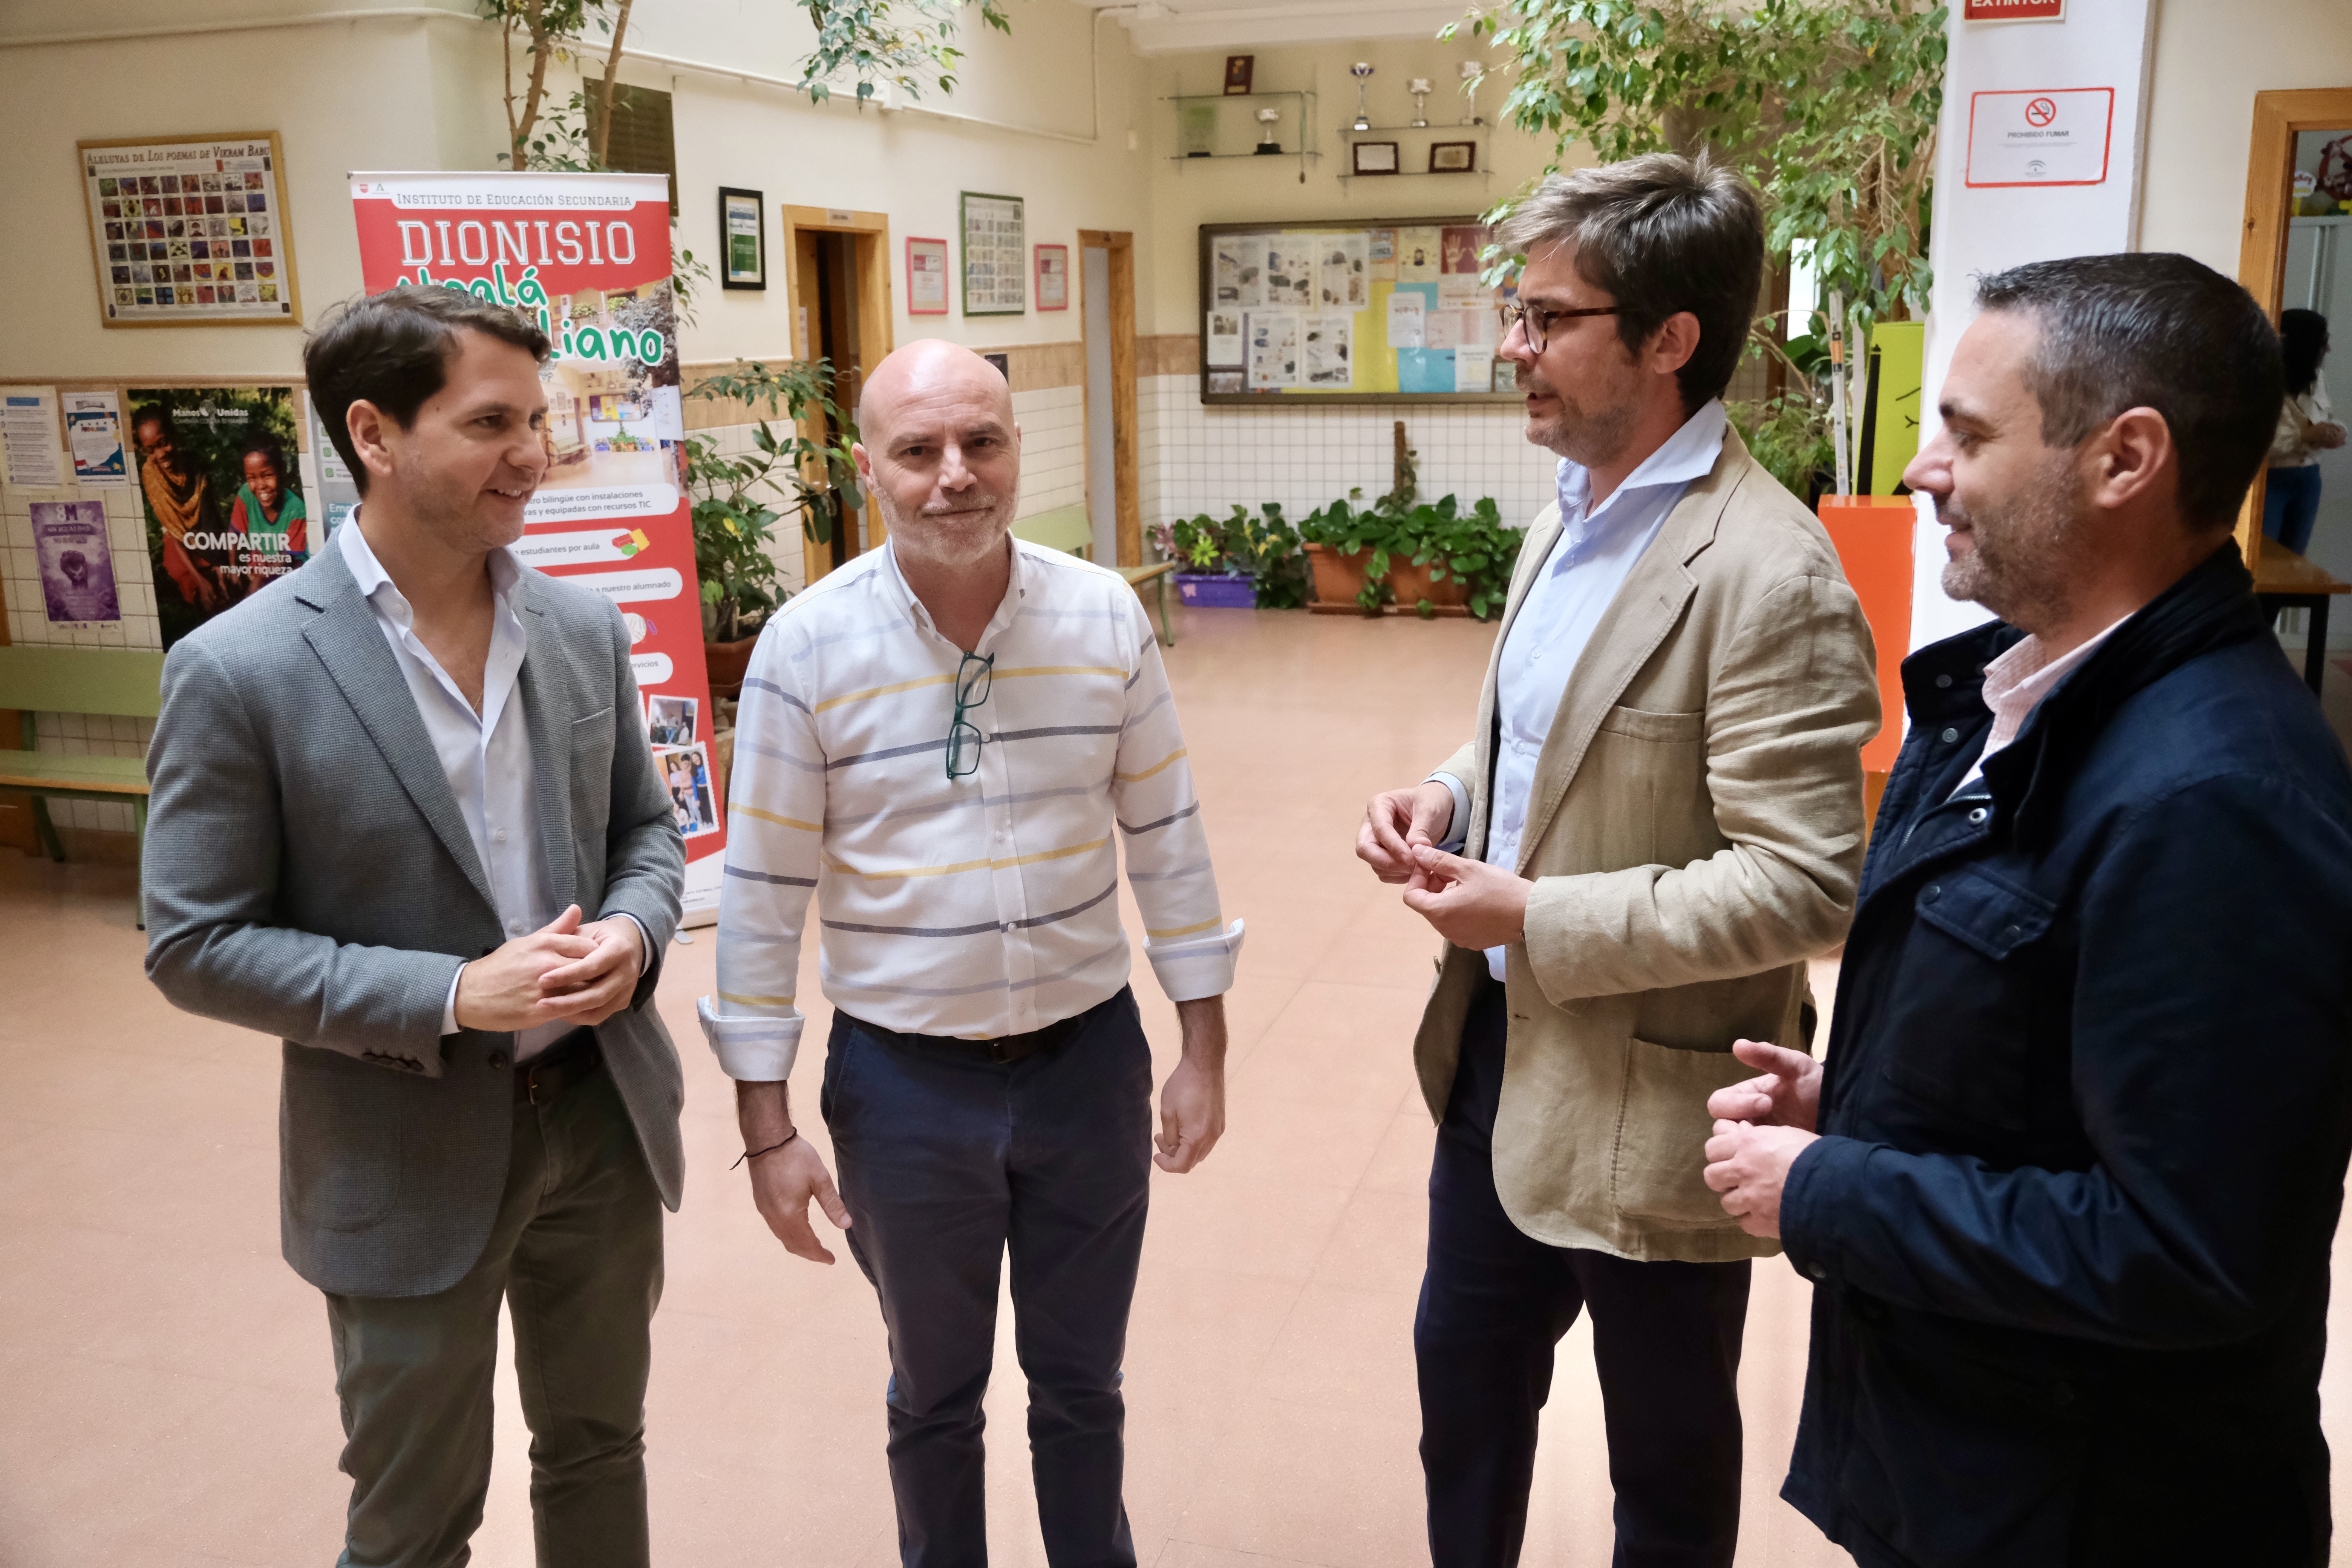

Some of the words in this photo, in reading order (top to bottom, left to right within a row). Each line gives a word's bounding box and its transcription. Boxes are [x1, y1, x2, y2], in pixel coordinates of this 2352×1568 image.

[397, 193, 462, 205] INSTITUTO
[467, 194, 482, 205] DE
[487, 194, 554, 205] EDUCACIÓN
[558, 194, 632, 206] SECUNDARIA
[396, 219, 636, 265] DIONISIO
[172, 409, 200, 417] Manos
[216, 408, 249, 416] Unidas
[542, 495, 574, 504] bilingüe
[591, 492, 643, 500] instalaciones
[545, 505, 586, 516] equipadas
[183, 532, 291, 551] COMPARTIR
[521, 547, 567, 556] estudiantes
[239, 554, 251, 562] es
[252, 553, 292, 563] nuestra
[219, 565, 253, 577] mayor
[254, 563, 293, 577] riqueza
[633, 581, 672, 590] alumnado
